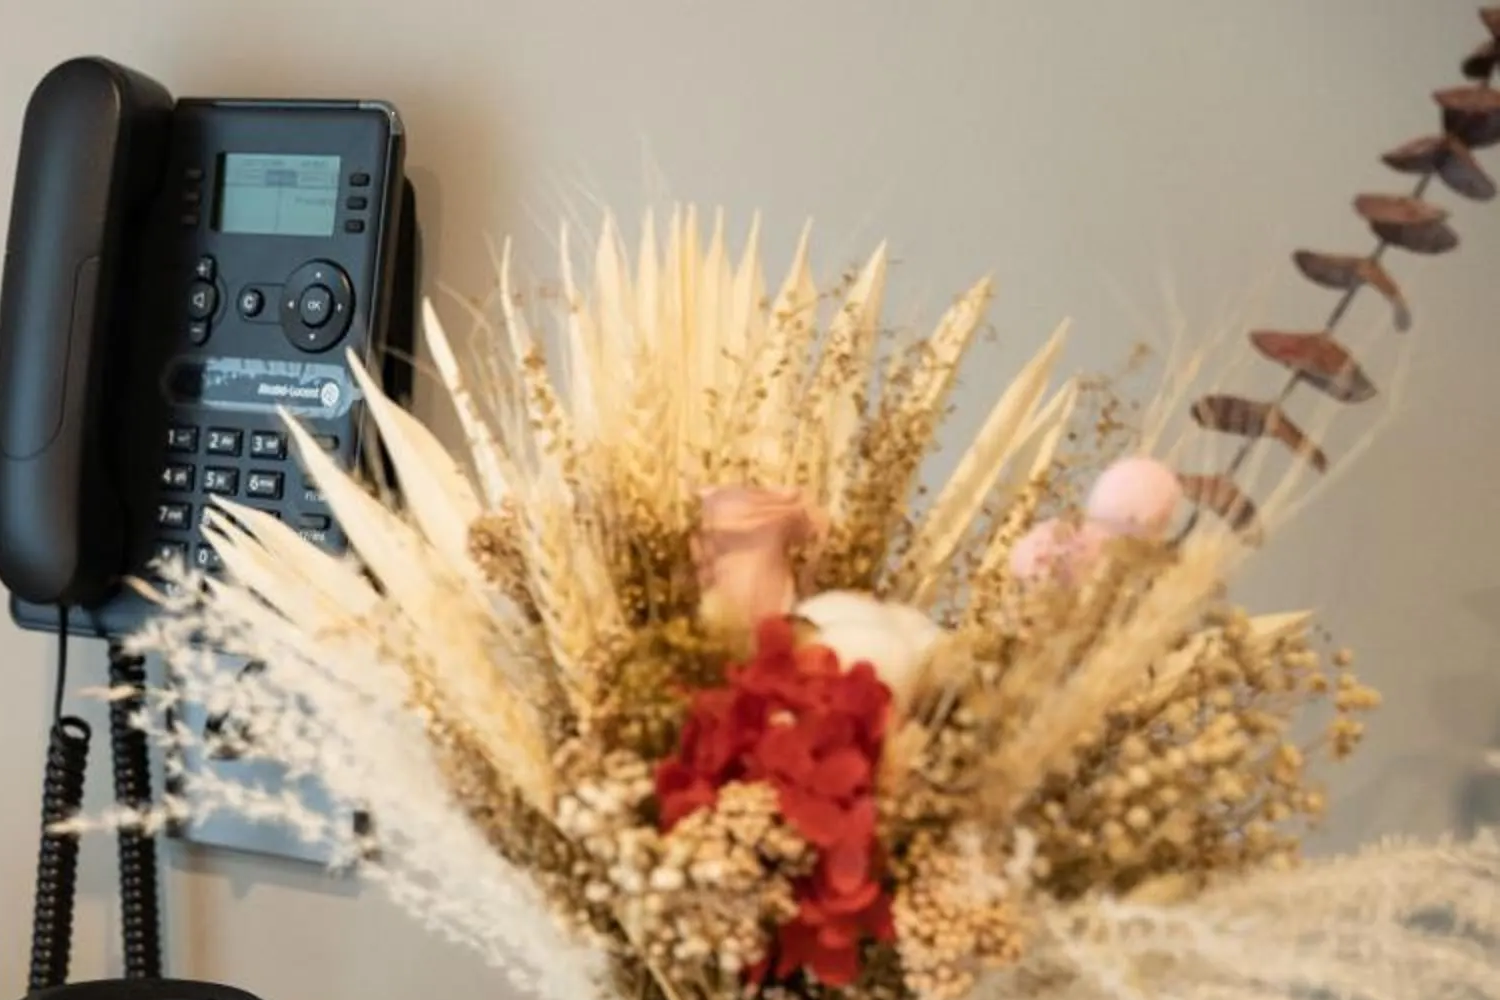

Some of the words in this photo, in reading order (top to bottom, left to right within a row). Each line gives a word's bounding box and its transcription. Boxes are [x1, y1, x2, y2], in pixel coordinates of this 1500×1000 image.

[243, 294, 254, 311] C
[307, 300, 321, 312] OK
[208, 432, 219, 449] 2
[252, 435, 263, 452] 3
[162, 467, 171, 481] 4
[204, 471, 215, 487] 5
[249, 474, 259, 491] 6
[159, 506, 167, 522] 7
